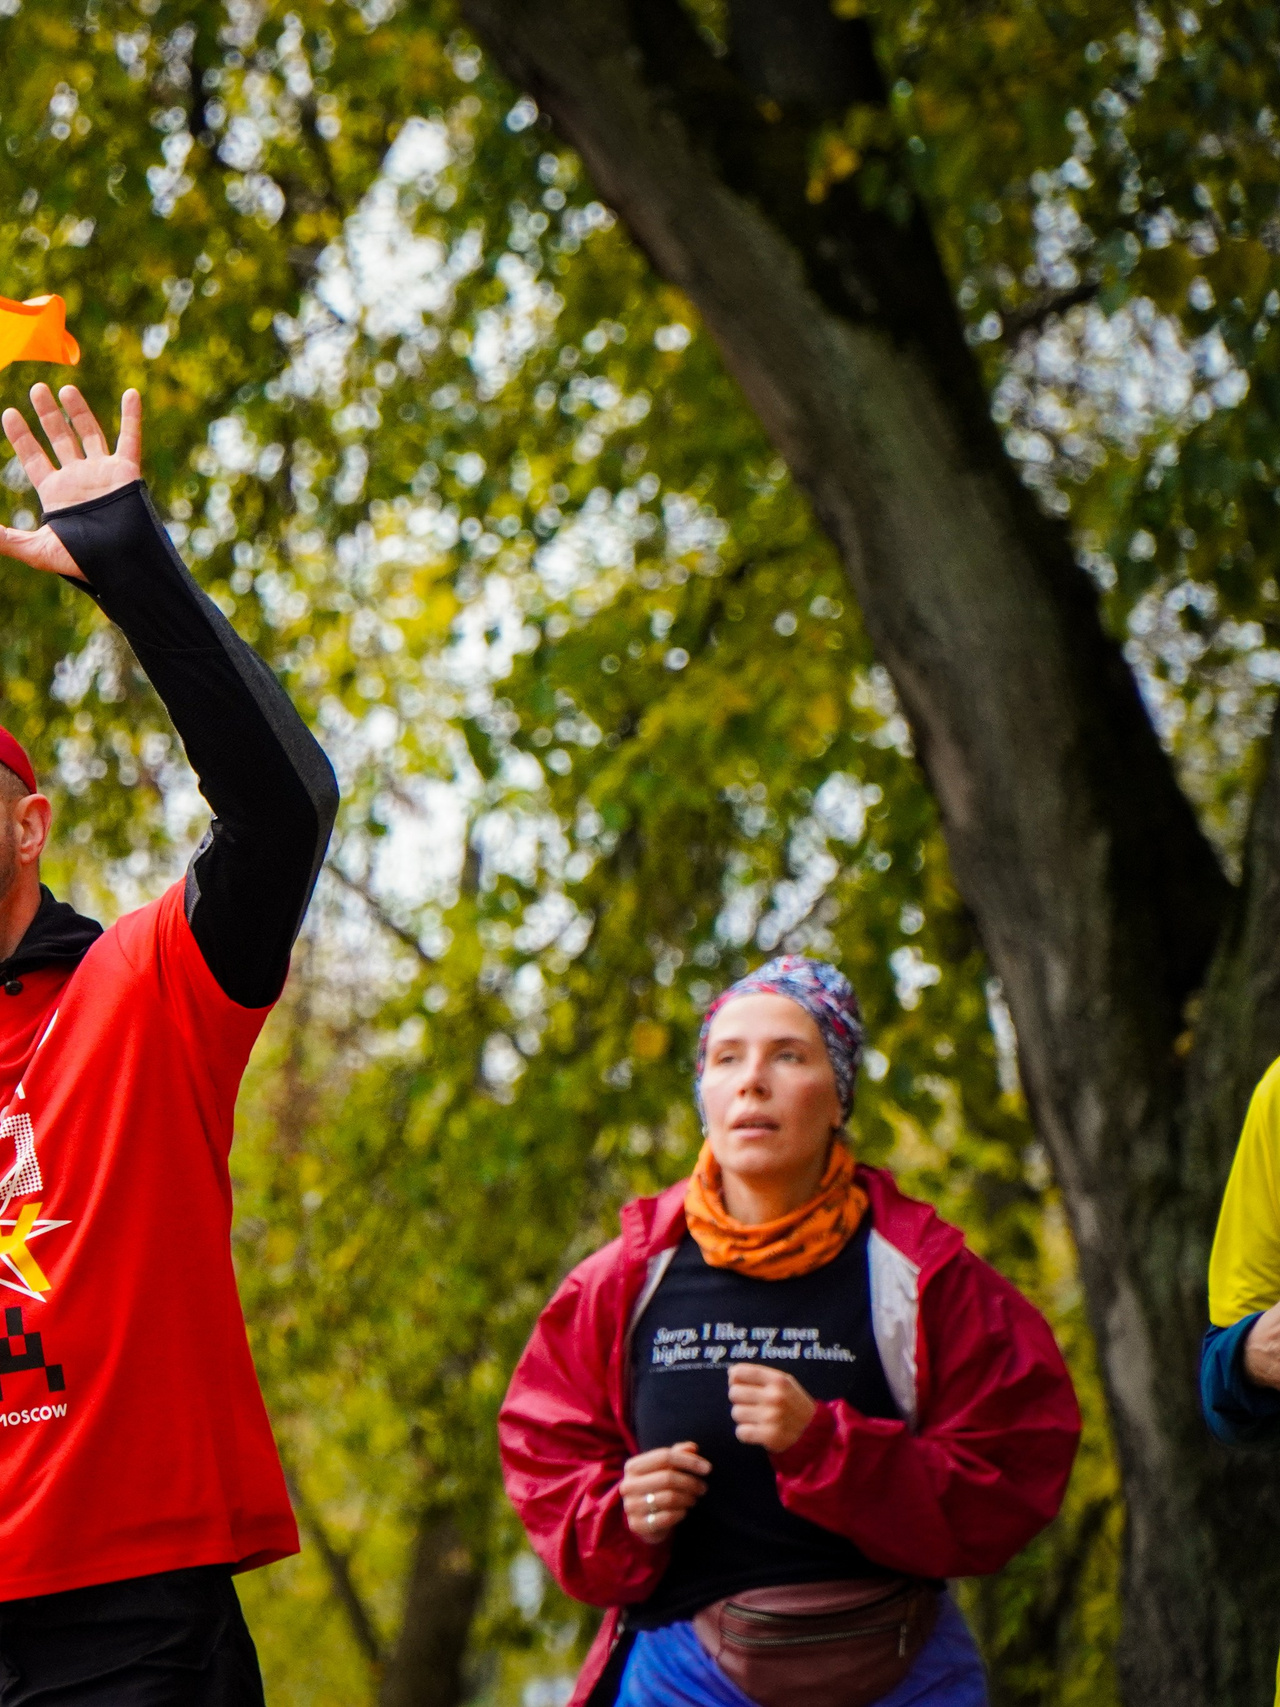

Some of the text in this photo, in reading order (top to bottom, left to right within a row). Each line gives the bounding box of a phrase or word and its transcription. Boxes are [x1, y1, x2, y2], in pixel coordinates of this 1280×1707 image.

[701, 1322, 711, 1341] I
[714, 1322, 748, 1341] like
[750, 1327, 779, 1346] my
[781, 1326, 820, 1341] men
[651, 1345, 701, 1367] higher
[703, 1345, 727, 1363] up
[729, 1340, 759, 1360] the
[760, 1340, 801, 1360] food
[803, 1343, 857, 1363] chain.
